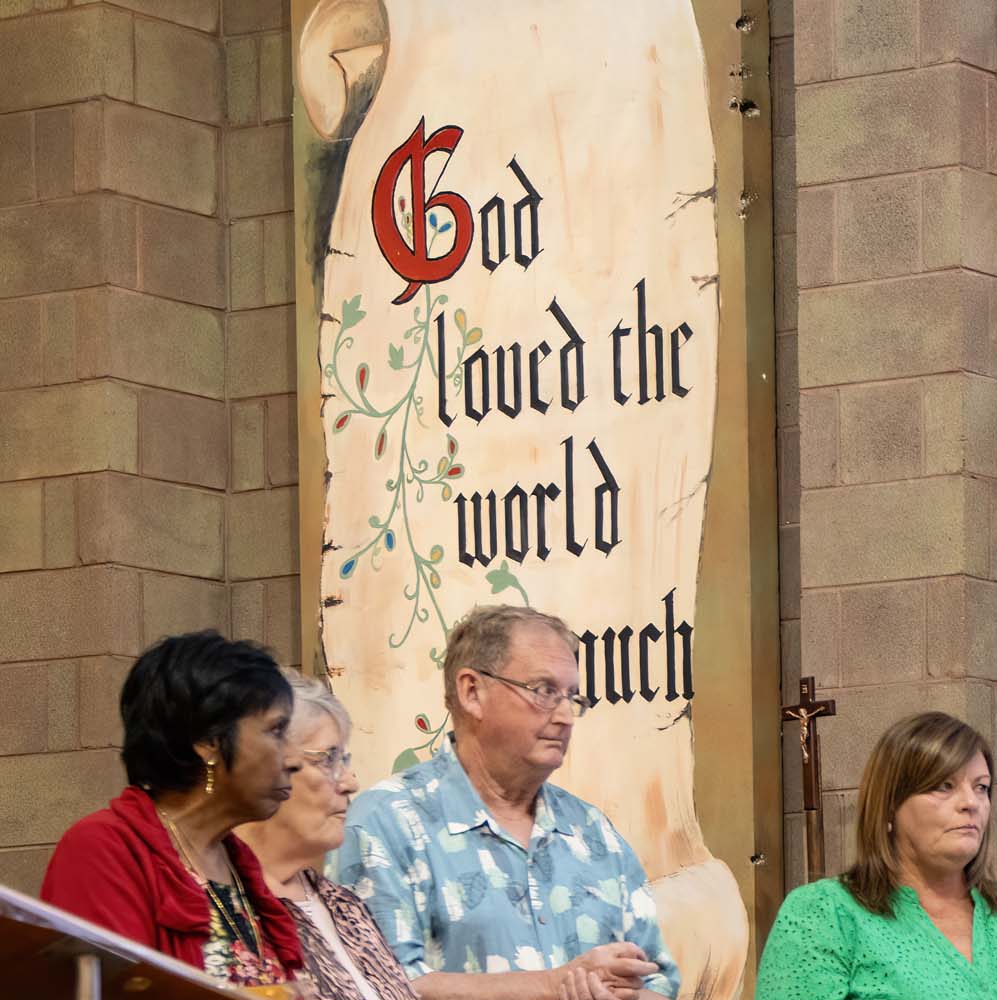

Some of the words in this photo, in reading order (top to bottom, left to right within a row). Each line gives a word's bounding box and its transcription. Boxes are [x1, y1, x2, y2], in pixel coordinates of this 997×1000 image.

[371, 115, 545, 305] God
[433, 296, 589, 427] loved
[609, 278, 694, 406] the
[453, 435, 623, 568] world
